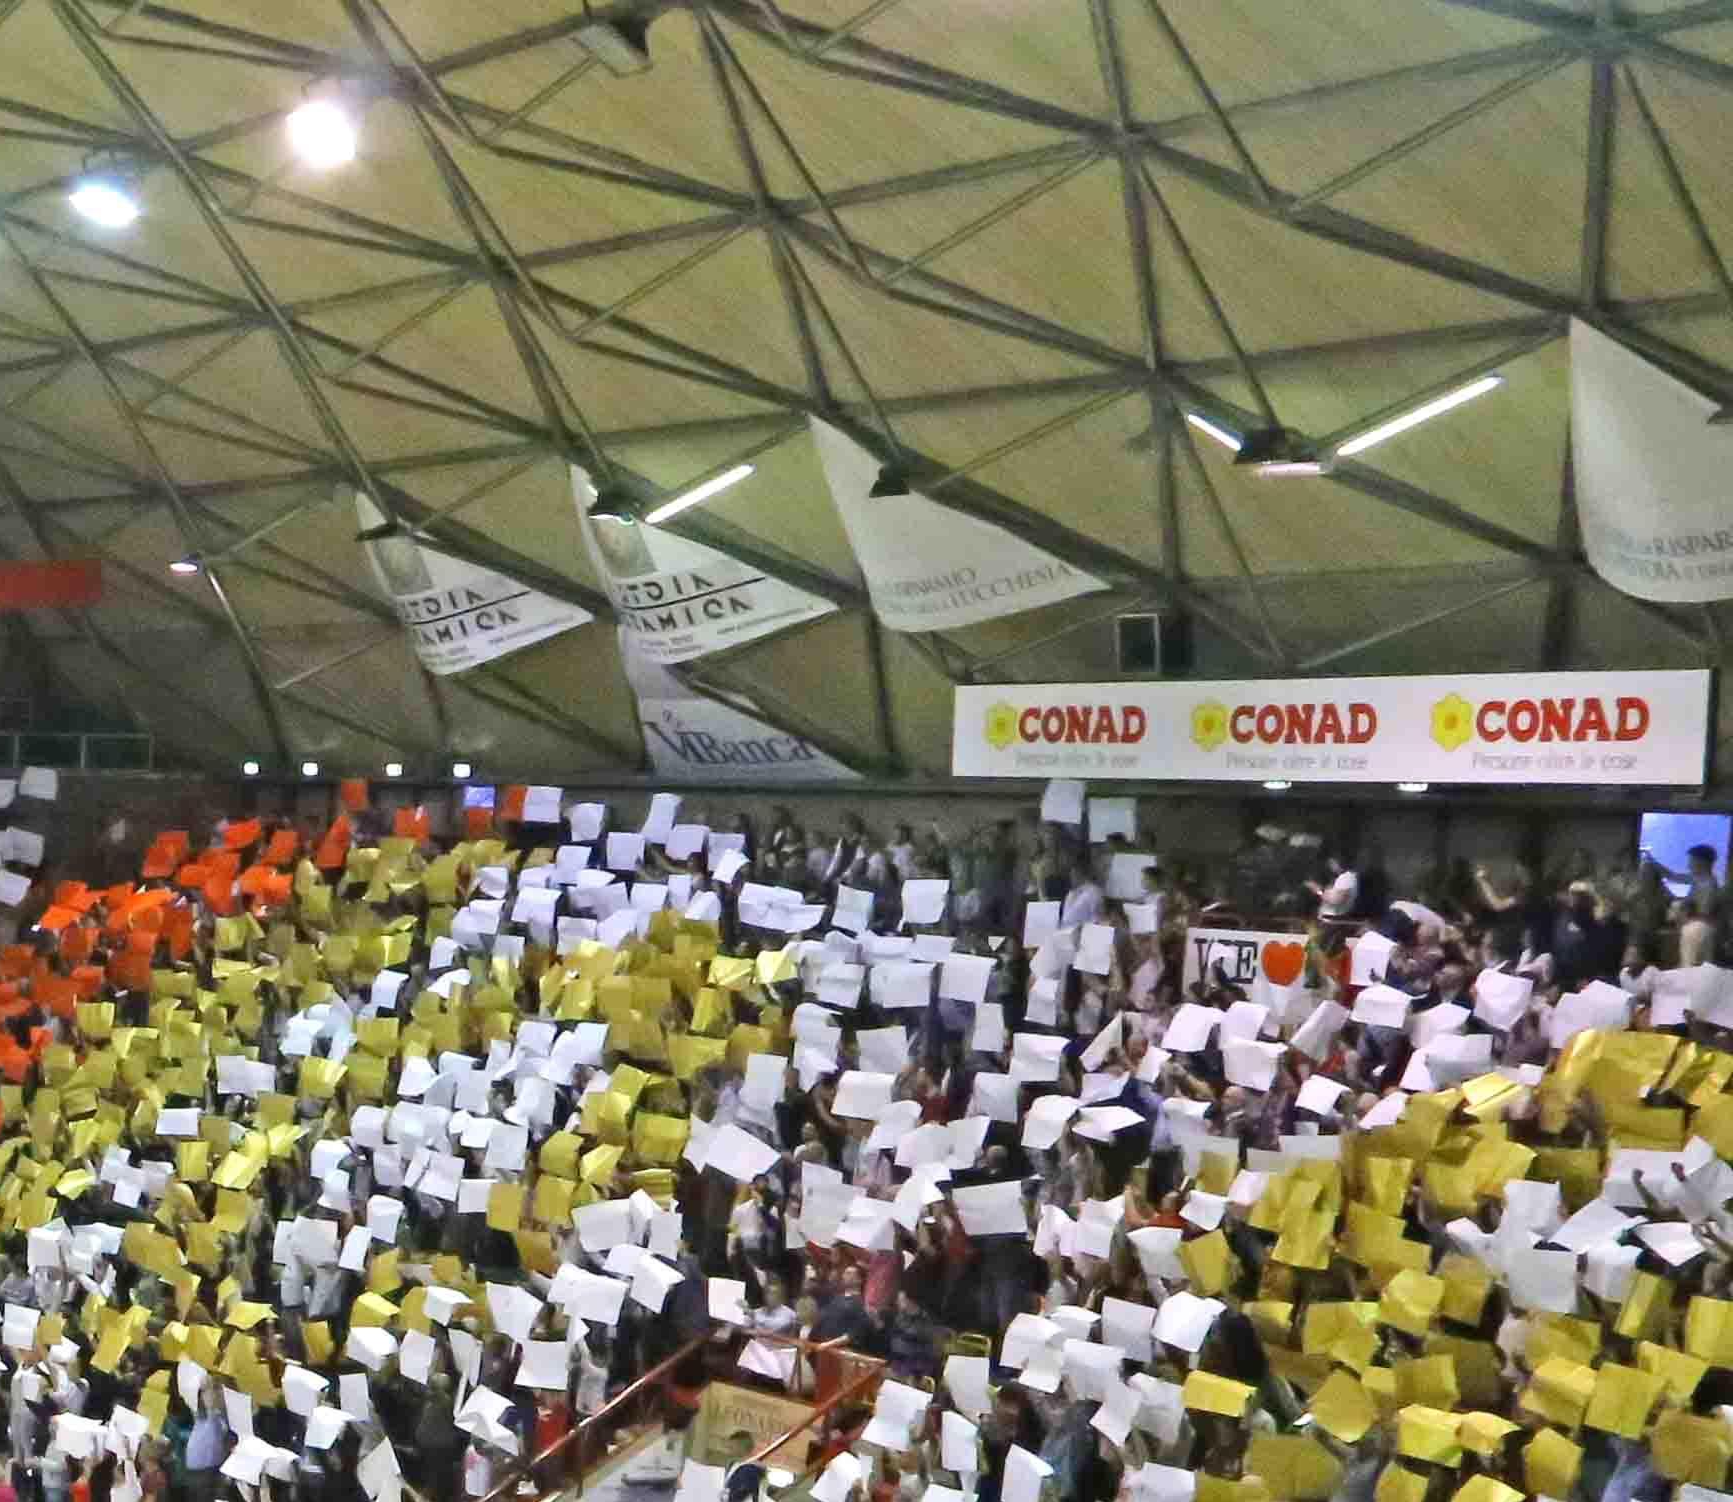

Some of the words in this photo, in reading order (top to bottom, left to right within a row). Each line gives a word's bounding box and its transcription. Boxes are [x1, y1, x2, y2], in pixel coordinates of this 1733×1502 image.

[1018, 705, 1147, 745] CONAD
[1230, 703, 1378, 746] CONAD
[1475, 696, 1651, 744] CONAD
